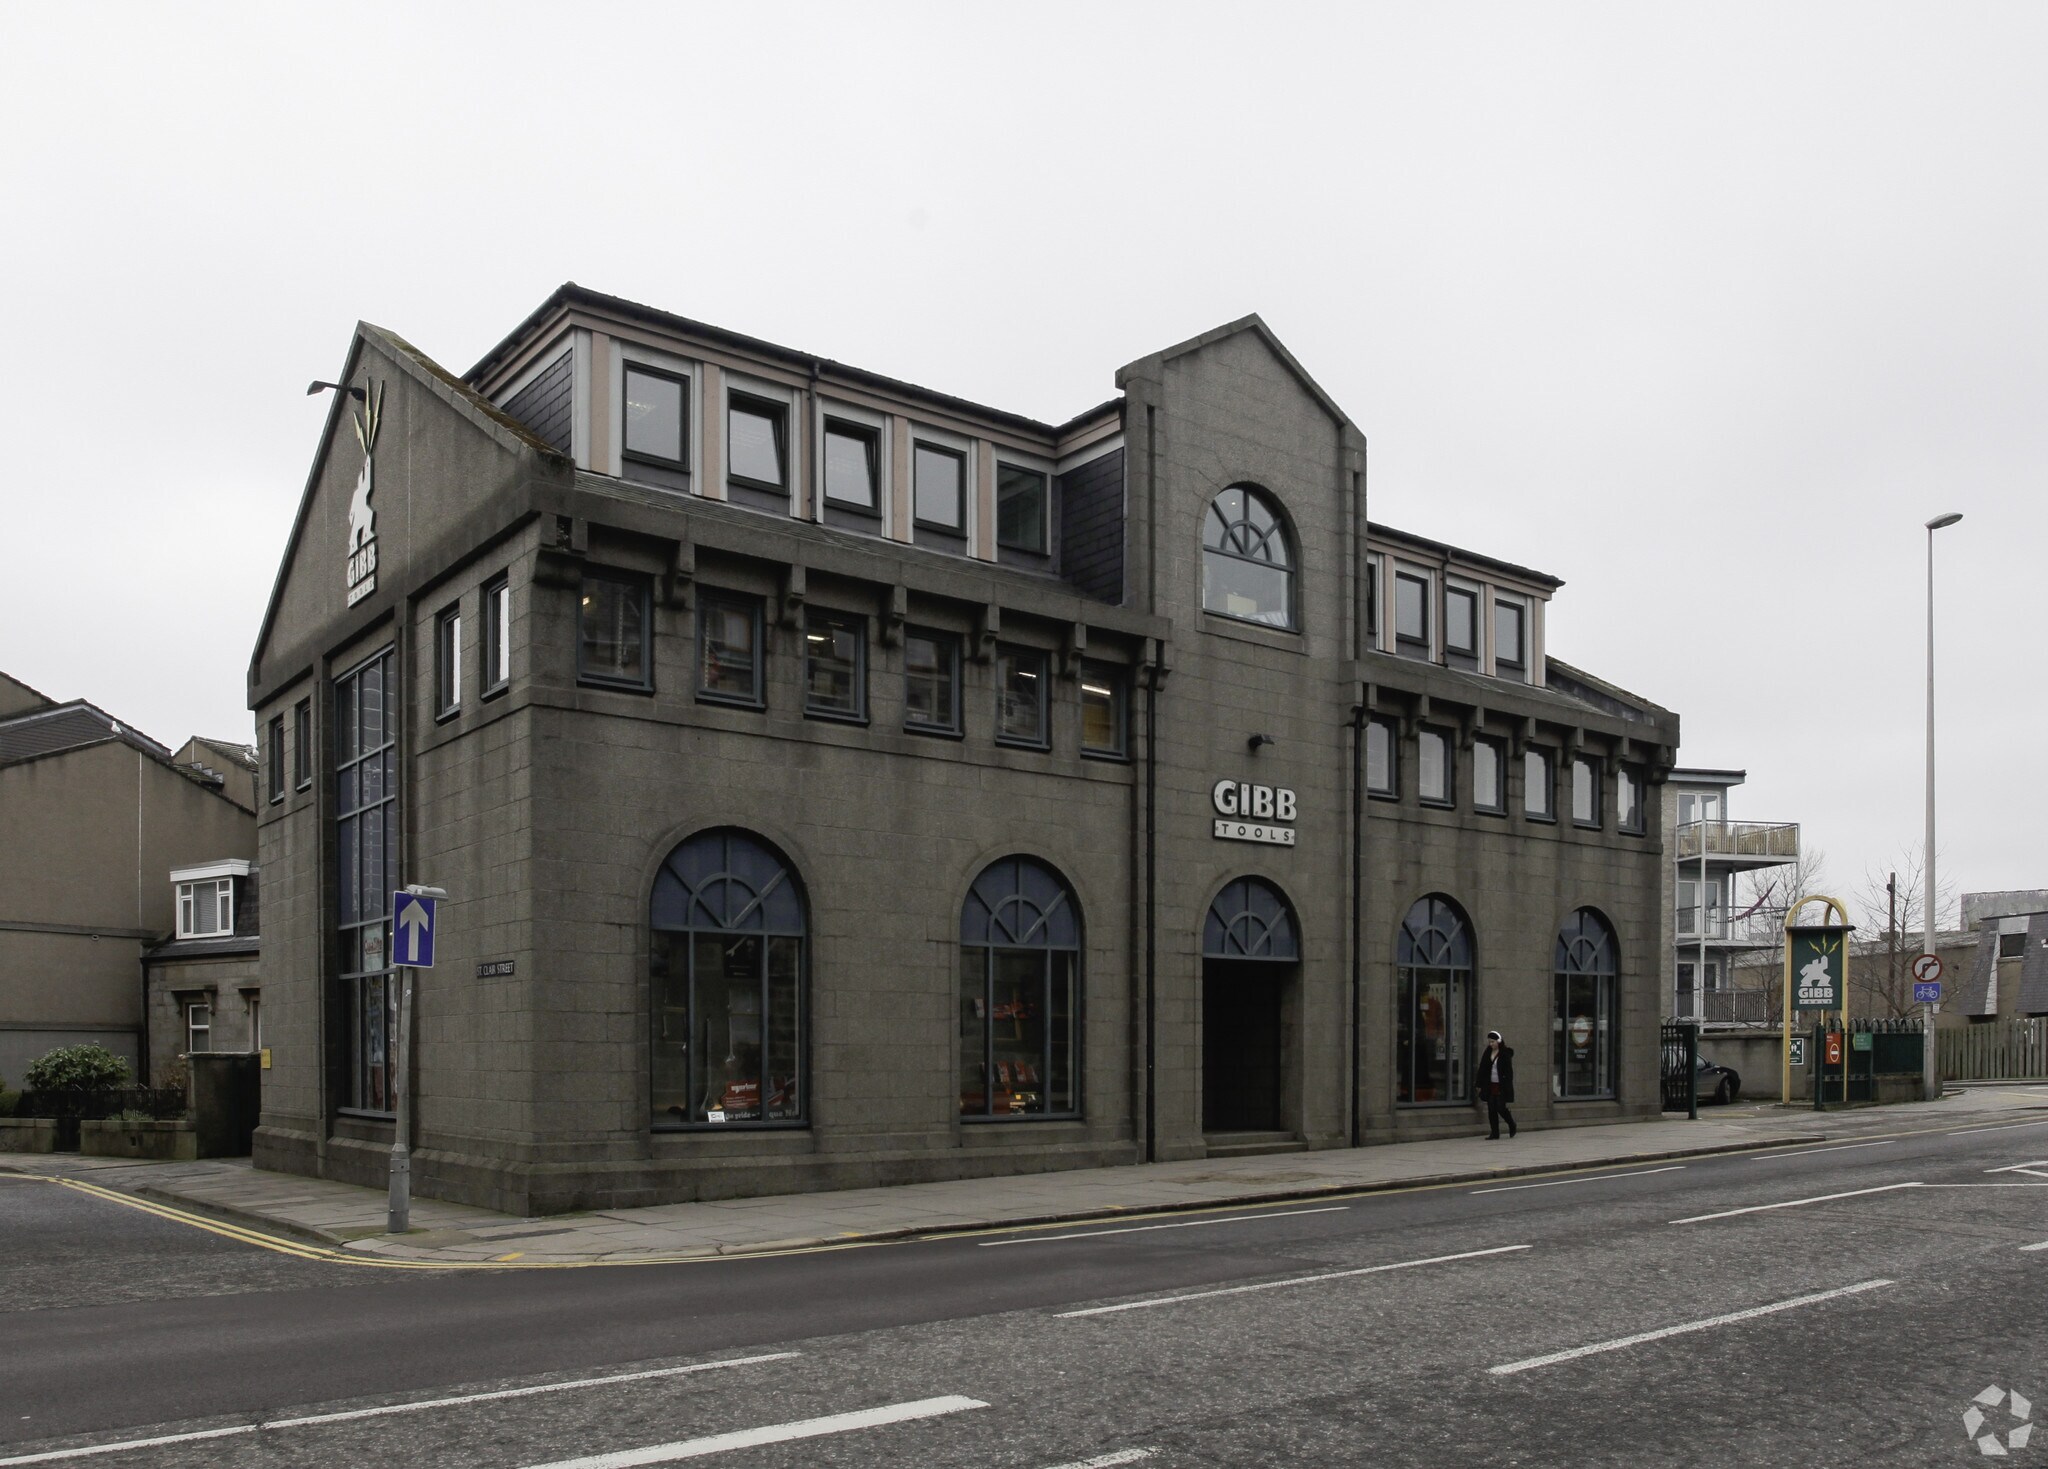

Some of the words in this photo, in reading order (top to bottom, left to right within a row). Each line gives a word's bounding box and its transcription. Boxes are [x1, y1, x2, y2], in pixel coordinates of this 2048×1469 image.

[347, 542, 376, 588] GIBB
[1214, 780, 1297, 821] GIBB
[1222, 824, 1290, 841] TOOLS
[497, 962, 514, 974] STREET
[1797, 988, 1834, 998] GIBB
